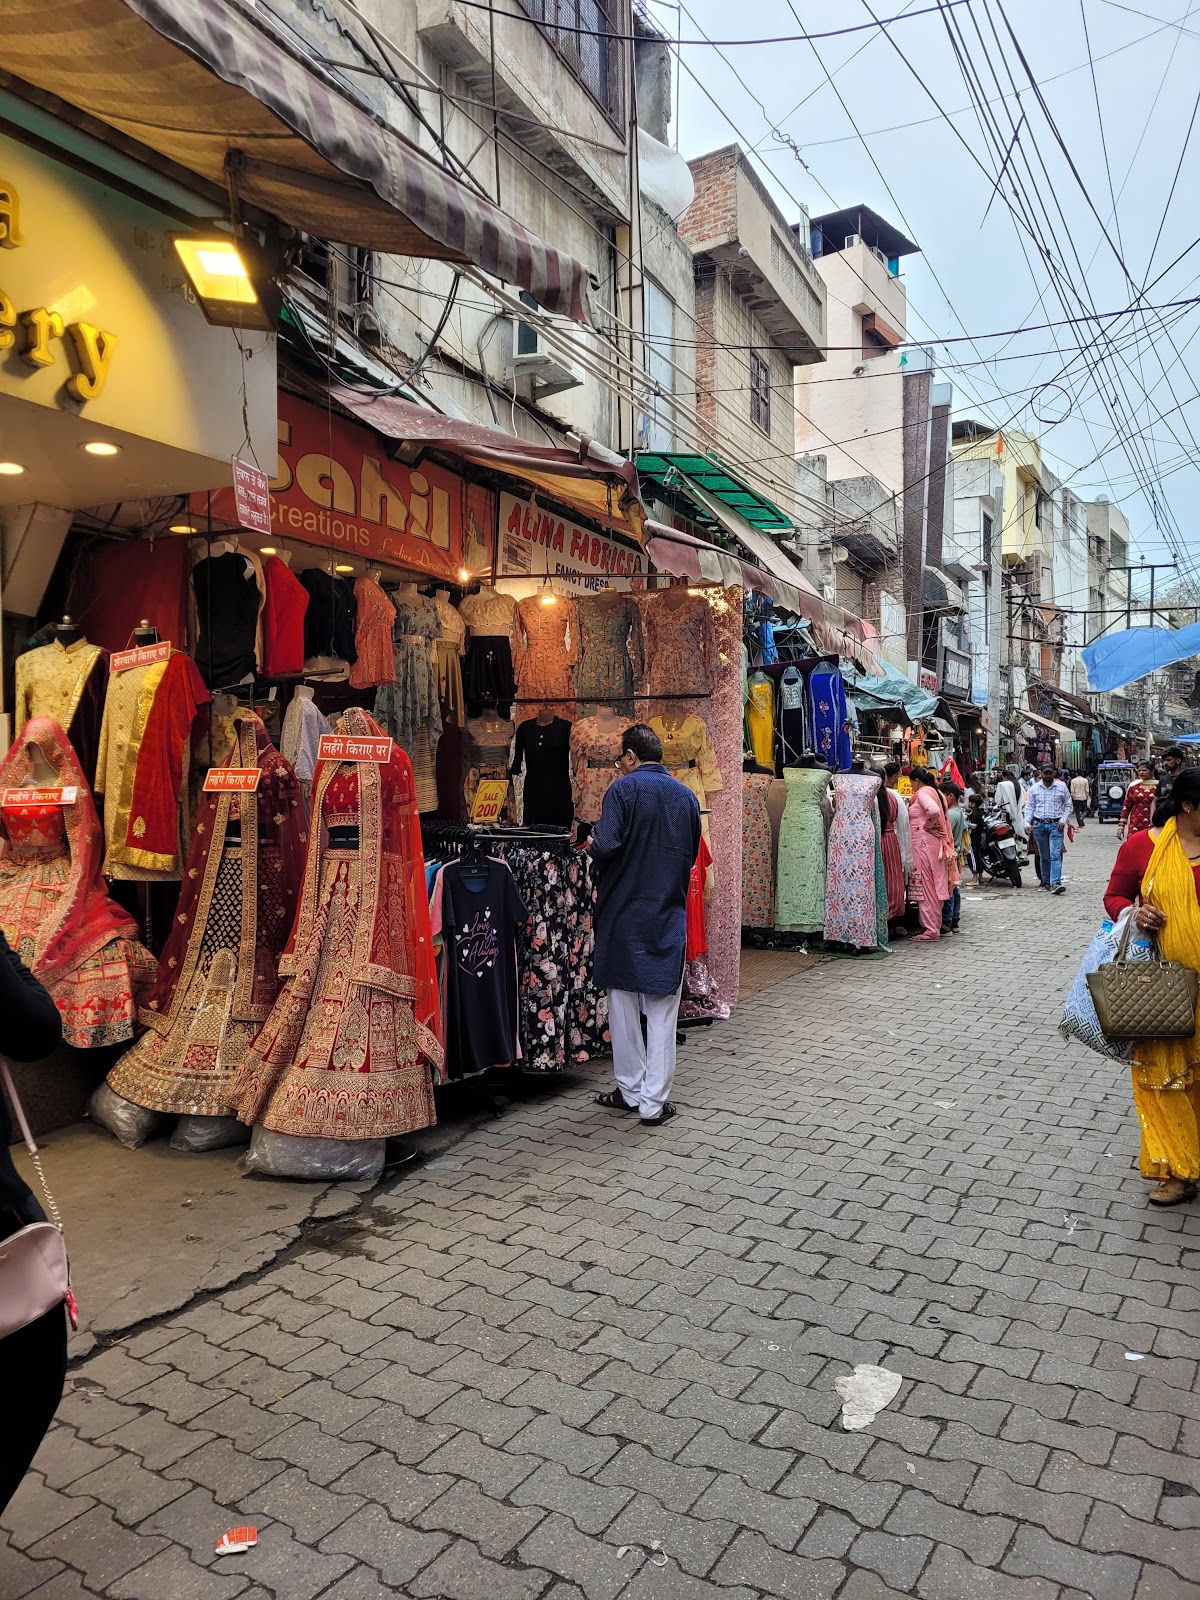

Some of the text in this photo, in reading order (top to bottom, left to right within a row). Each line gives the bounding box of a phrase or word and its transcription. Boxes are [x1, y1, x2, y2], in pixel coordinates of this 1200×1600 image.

[508, 502, 633, 576] ALINA FABRICS
[555, 562, 583, 586] FANCY
[138, 649, 157, 661] किराए
[158, 647, 167, 656] पर
[346, 740, 374, 759] किराए
[376, 745, 388, 756] पर
[225, 772, 246, 788] किराए
[247, 775, 257, 786] पर
[31, 791, 60, 802] किराए
[483, 793, 499, 801] SALE
[476, 804, 498, 817] 200
